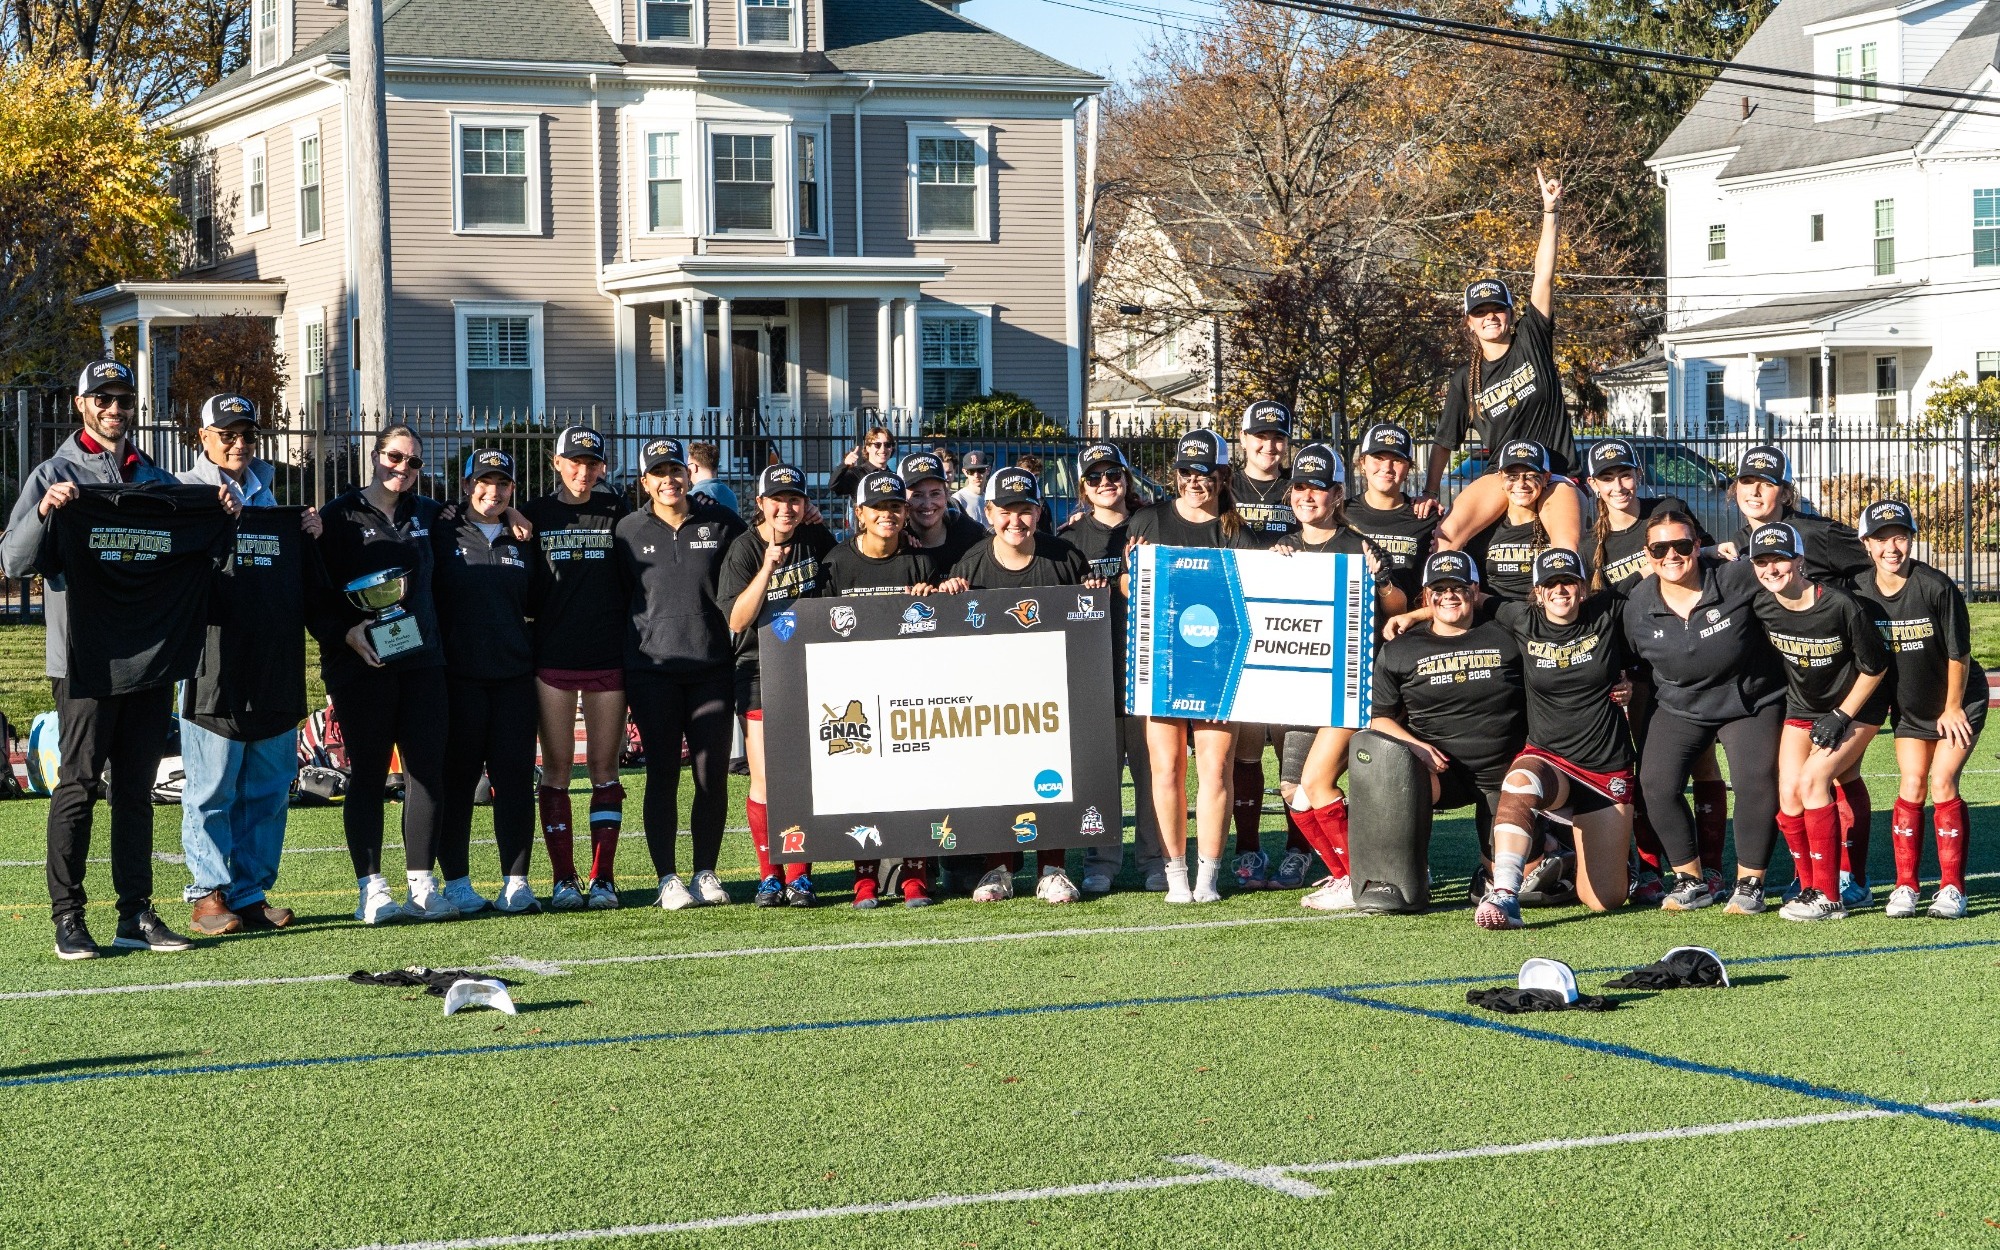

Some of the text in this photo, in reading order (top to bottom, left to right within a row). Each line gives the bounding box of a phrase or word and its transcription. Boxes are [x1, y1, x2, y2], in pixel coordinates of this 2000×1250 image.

[1490, 402, 1509, 418] 2025
[1236, 508, 1296, 525] AMPIONS
[89, 533, 172, 553] CHAMPIONS
[237, 539, 281, 556] MPIONS
[539, 533, 614, 551] CHAMPIONS
[100, 551, 122, 560] 2025
[254, 556, 272, 566] 2026
[550, 550, 605, 560] 2025 2026
[1175, 557, 1209, 570] #DIII
[1497, 563, 1519, 572] 2025
[767, 589, 788, 601] 2025
[1182, 624, 1219, 637] NCAA
[1264, 616, 1323, 633] TICKET
[1879, 622, 1934, 641] MPIONS
[1253, 639, 1331, 656] PUNCHED
[1769, 635, 1843, 657] CHAMPIONS
[1901, 641, 1924, 651] 2026
[1417, 653, 1502, 675] CHAMPIONS
[1536, 652, 1593, 668] 2025 2026
[1430, 669, 1491, 685] 2025 2026
[890, 696, 973, 707] FIELD HOCKEY
[1172, 699, 1206, 711] #DIII
[890, 701, 1060, 741] CHAMPIONS
[820, 722, 872, 742] GNAC
[892, 742, 931, 753] 2025
[1037, 782, 1063, 792] NCAA
[1082, 820, 1104, 830] NEC
